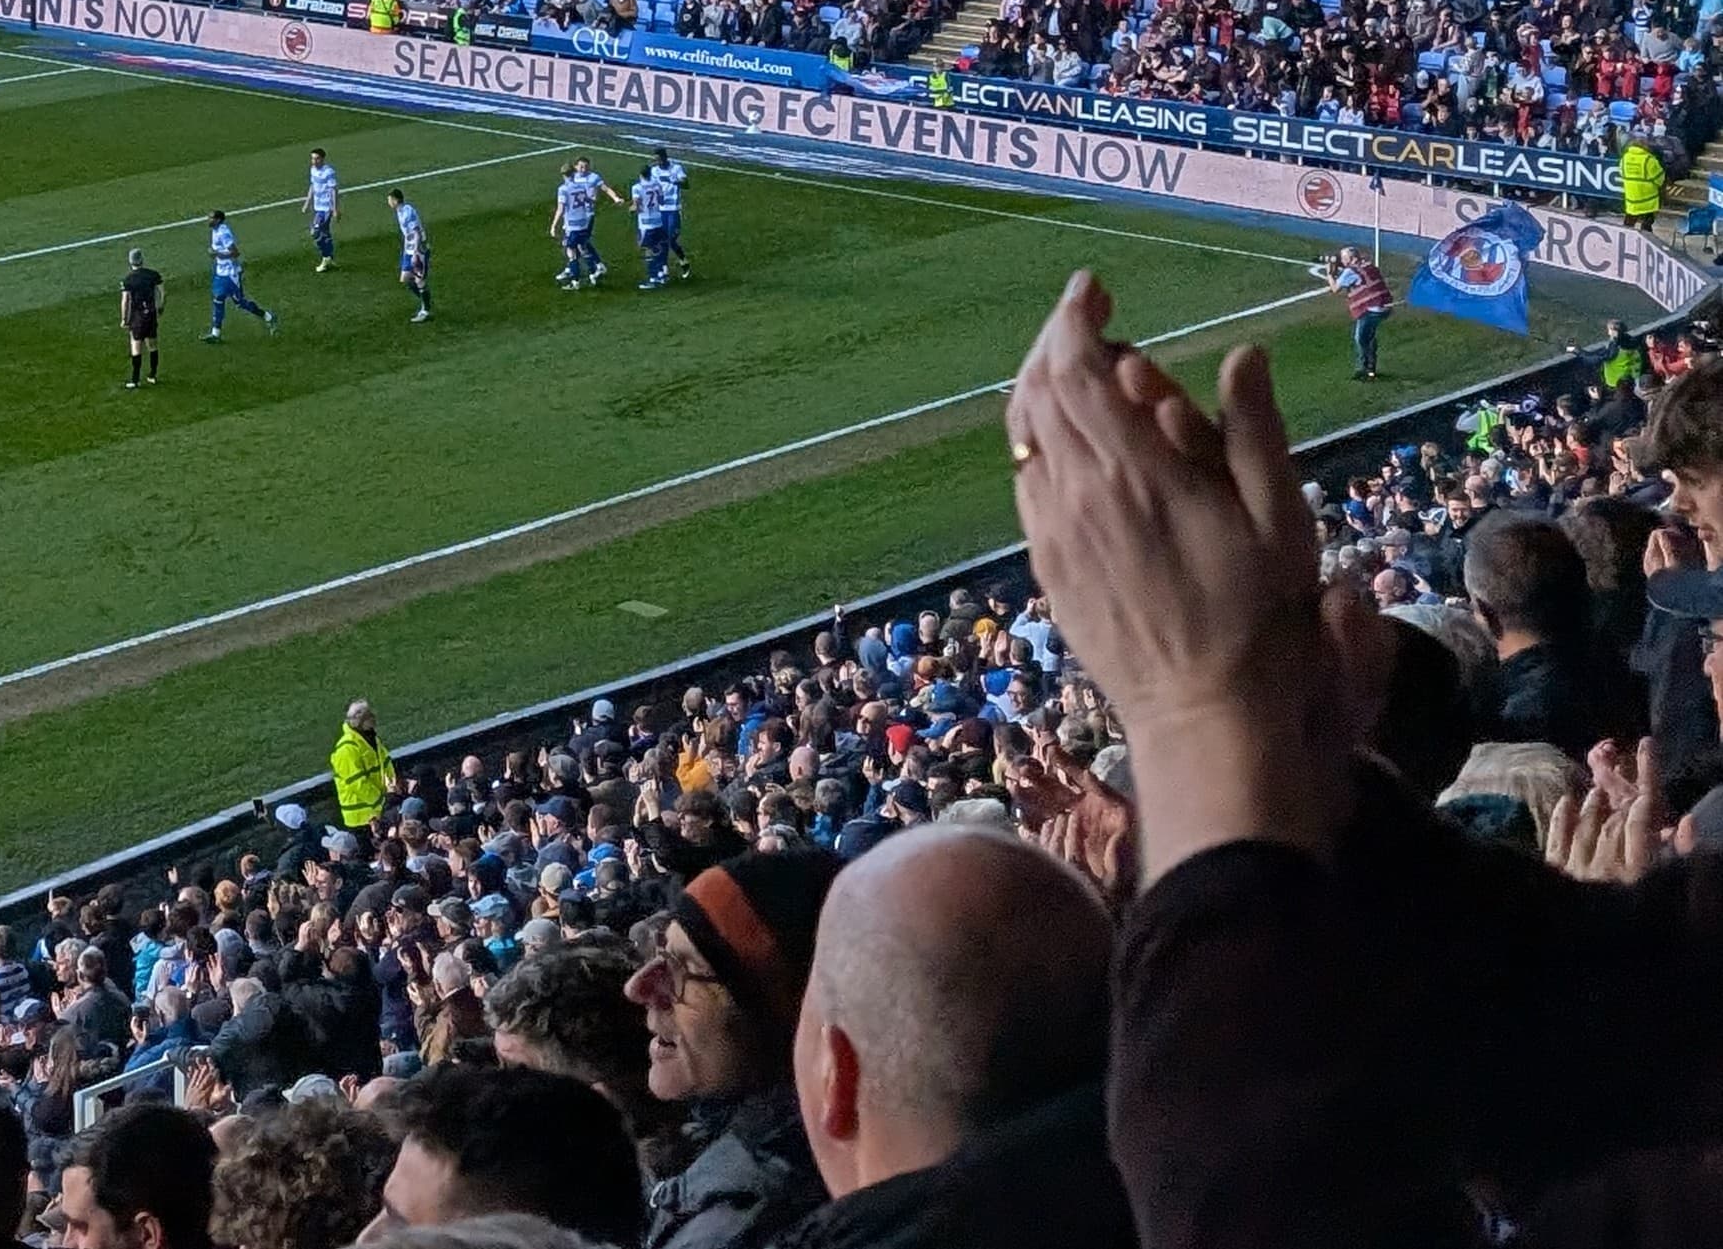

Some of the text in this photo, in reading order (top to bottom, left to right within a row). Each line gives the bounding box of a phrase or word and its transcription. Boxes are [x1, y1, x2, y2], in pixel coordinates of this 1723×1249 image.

[114, 0, 205, 45] NOW
[573, 26, 629, 60] CRL
[645, 42, 793, 78] www.crlfireflood.com
[394, 39, 1187, 193] SEARCH READING FC EVENTS NOW
[1232, 115, 1625, 194] SELECTCARLEASING
